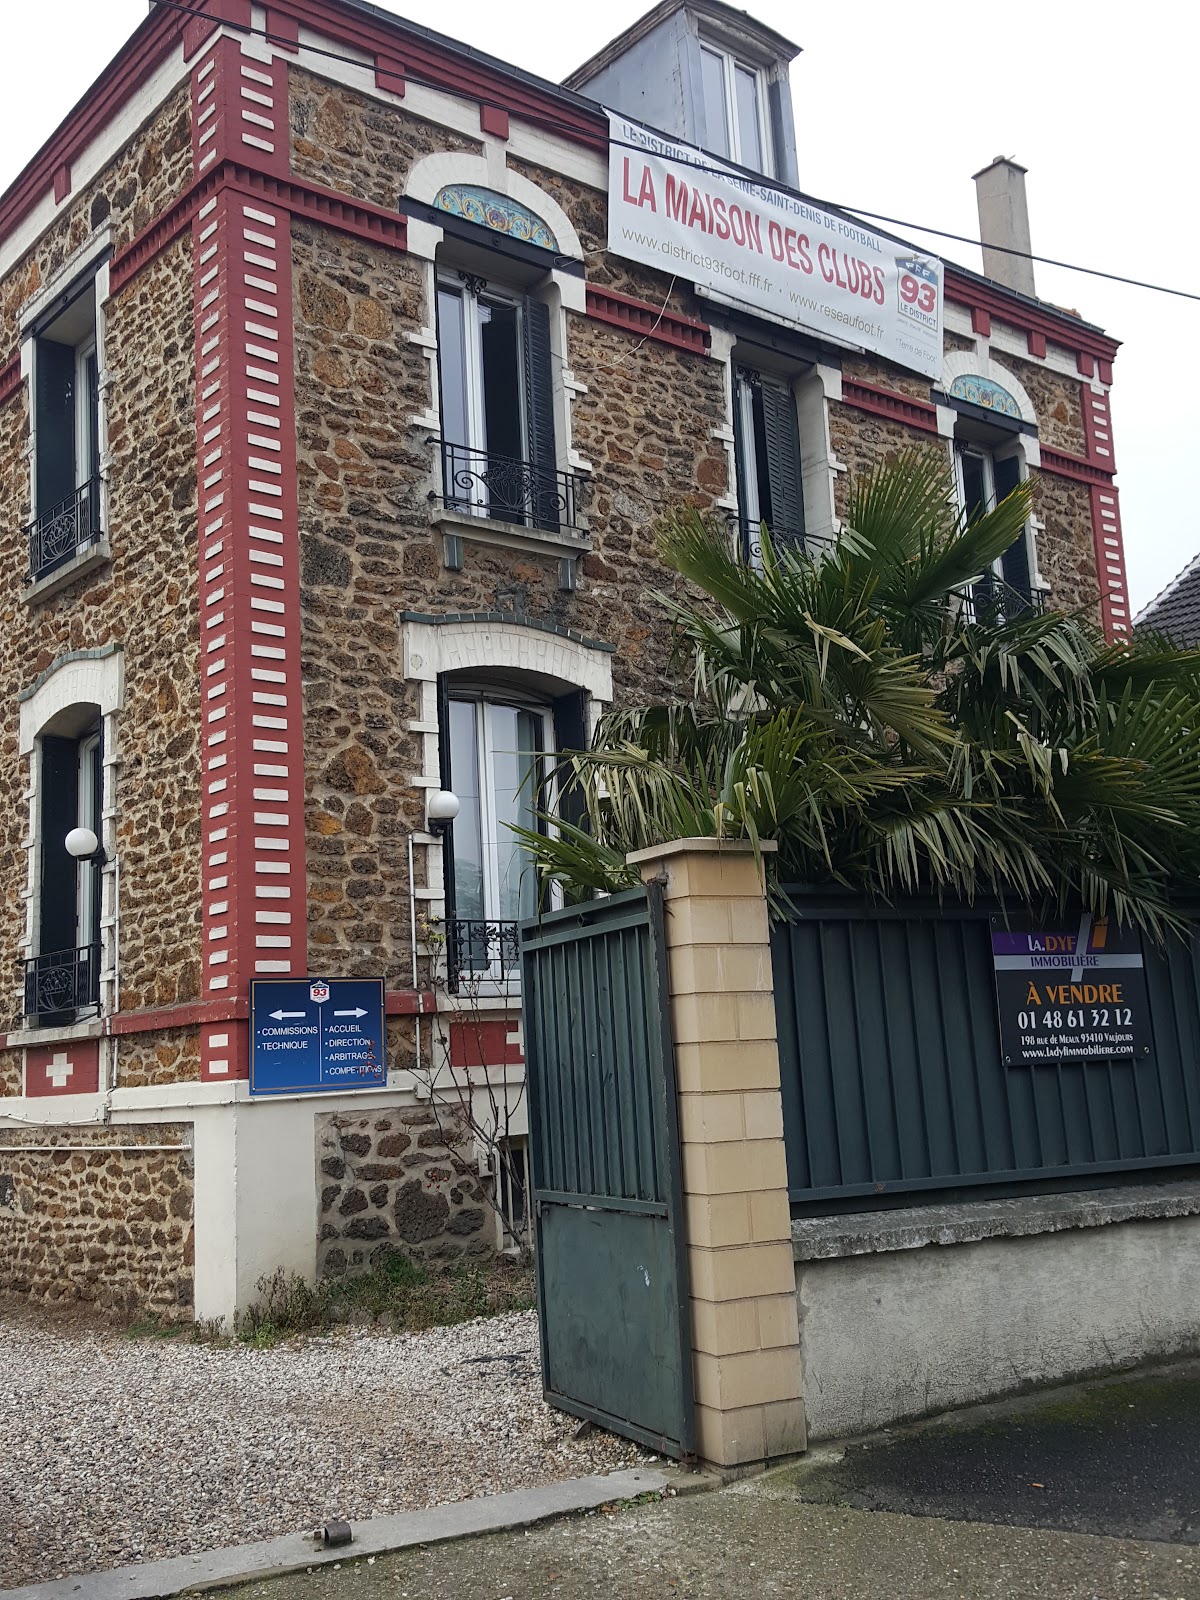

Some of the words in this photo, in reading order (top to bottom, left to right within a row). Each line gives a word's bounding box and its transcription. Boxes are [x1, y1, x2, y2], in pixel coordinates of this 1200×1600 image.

[623, 125, 637, 142] LE
[823, 215, 837, 232] DE
[838, 222, 882, 253] FOOTBALL
[622, 156, 657, 213] LA
[665, 173, 763, 255] MAISON
[768, 220, 814, 275] DES
[817, 242, 885, 306] CLUBS
[621, 226, 773, 293] www.district93foot.fff.fr
[789, 290, 885, 339] www.reseaufoot.fr
[900, 274, 936, 313] 93
[900, 302, 909, 313] LE
[909, 306, 937, 327] DISTRICT
[1030, 954, 1099, 967] IMMOBILIÈRE
[313, 988, 327, 997] 93
[1026, 981, 1042, 1005] À
[1046, 984, 1124, 1005] VENDRE
[1017, 1011, 1036, 1030] 01
[1042, 1010, 1062, 1029] 48
[1067, 1009, 1085, 1028] 61
[1092, 1008, 1110, 1027] 32
[1115, 1008, 1133, 1026] 12
[262, 1025, 318, 1036] COMMISSIONS
[328, 1025, 362, 1033] ACCUEIL
[262, 1041, 308, 1051] TECHNIQUE
[329, 1038, 371, 1047] DIRECTION
[1021, 1035, 1035, 1046] 198
[1080, 1033, 1103, 1043] 93410
